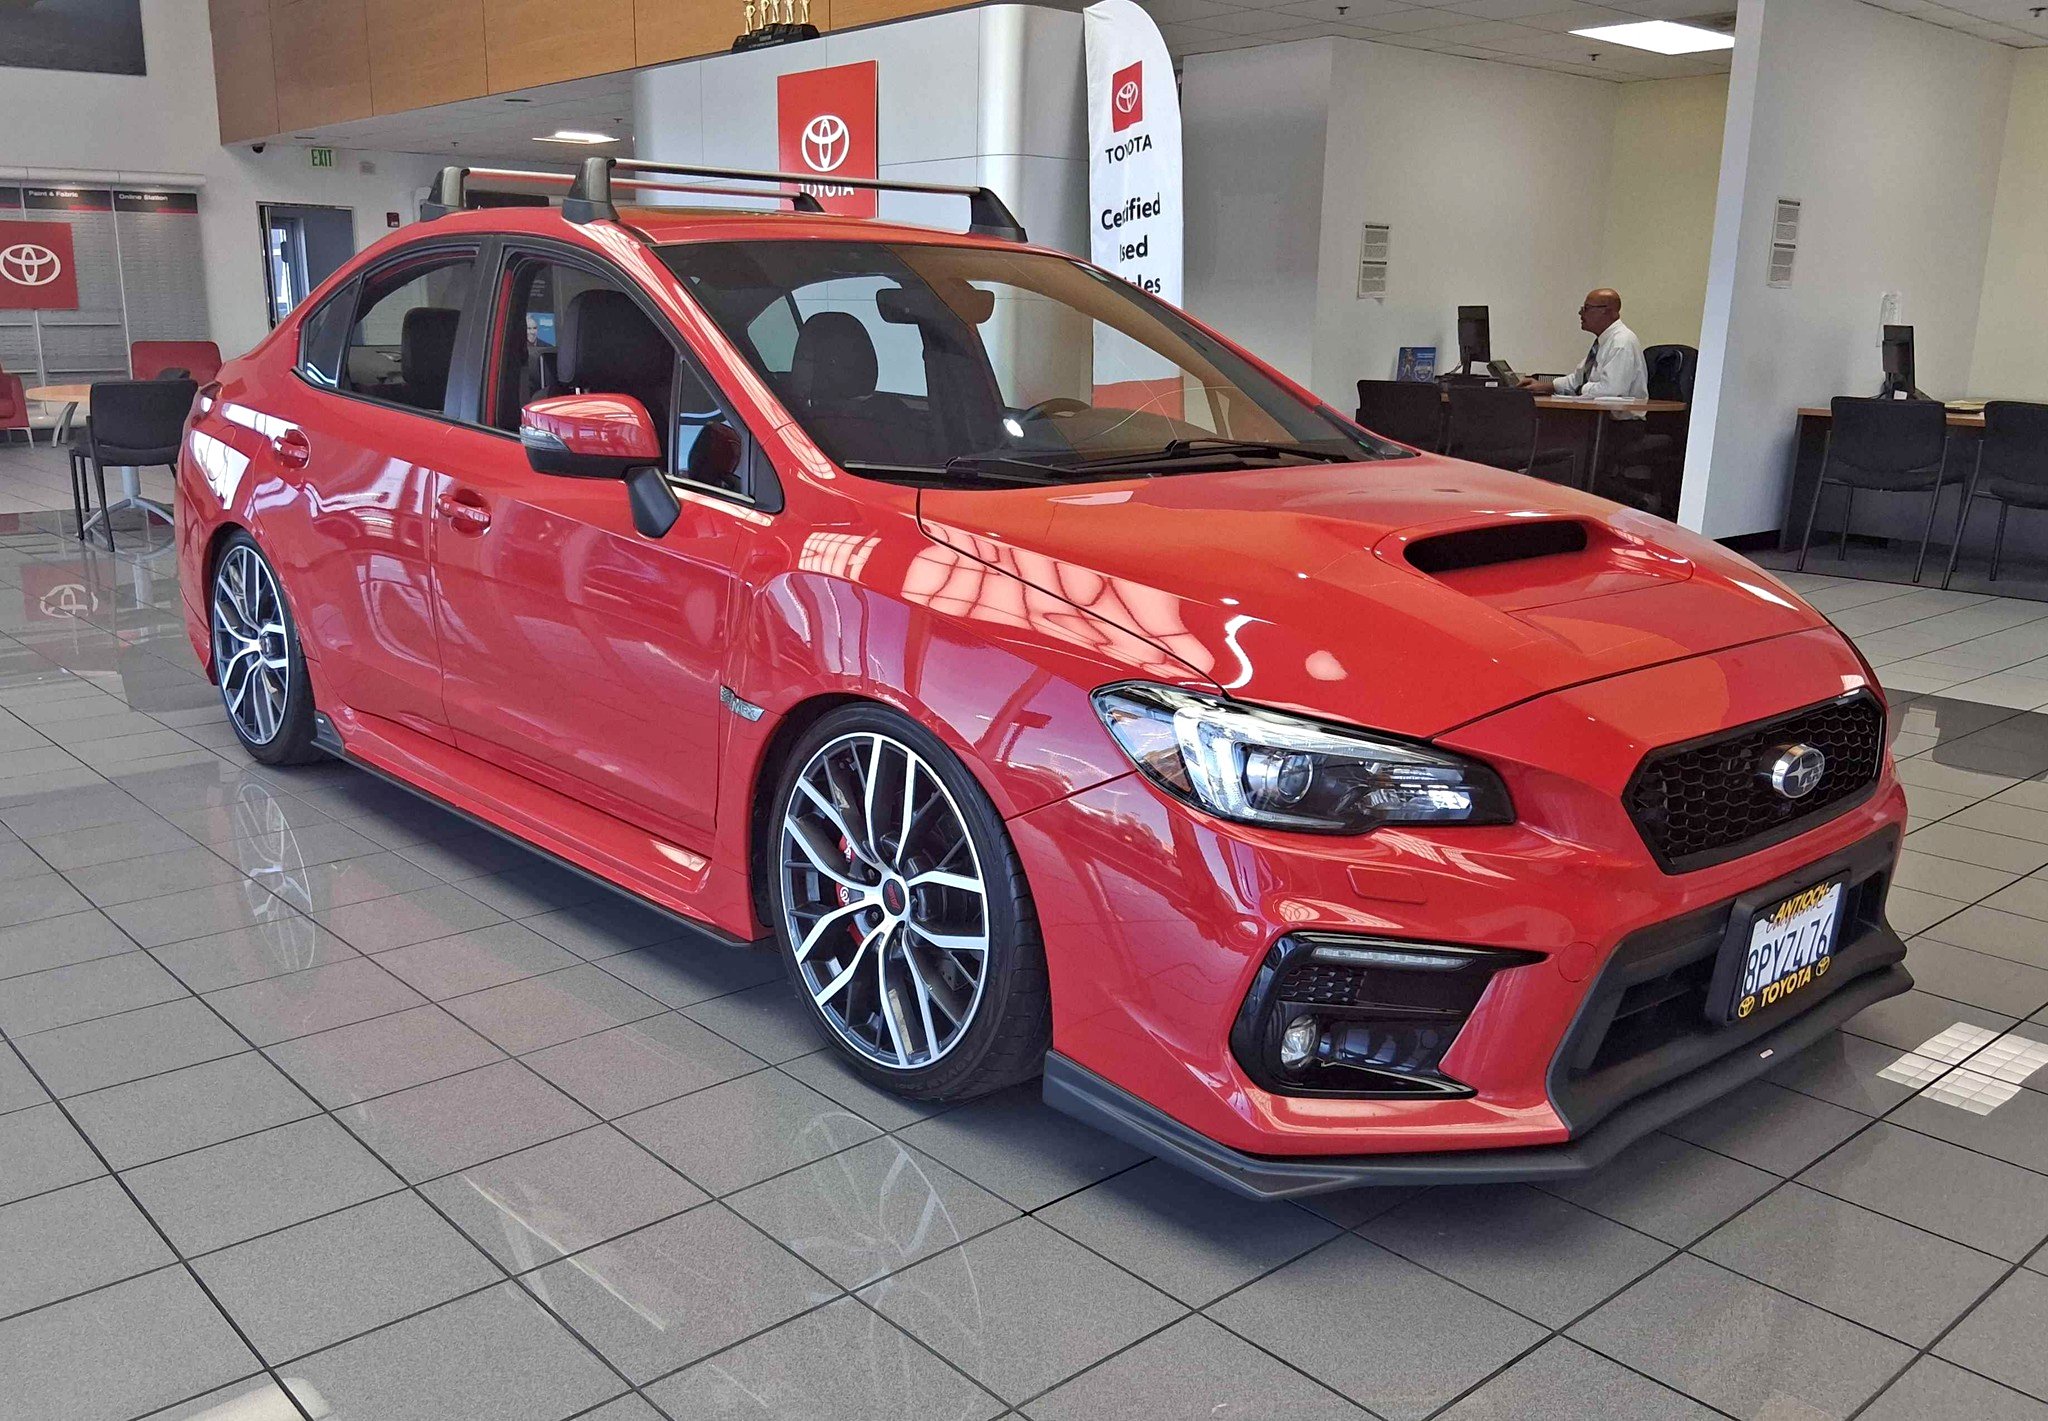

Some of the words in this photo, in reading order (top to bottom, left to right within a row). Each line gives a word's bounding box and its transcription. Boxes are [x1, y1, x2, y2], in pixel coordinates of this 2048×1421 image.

[311, 149, 333, 167] EXIT
[1101, 192, 1160, 230] Ceified
[1120, 234, 1148, 262] sed
[1774, 882, 1829, 926] ANTIOCH
[1743, 912, 1834, 997] 8PYZ476
[1761, 965, 1812, 1007] TOYOTA
